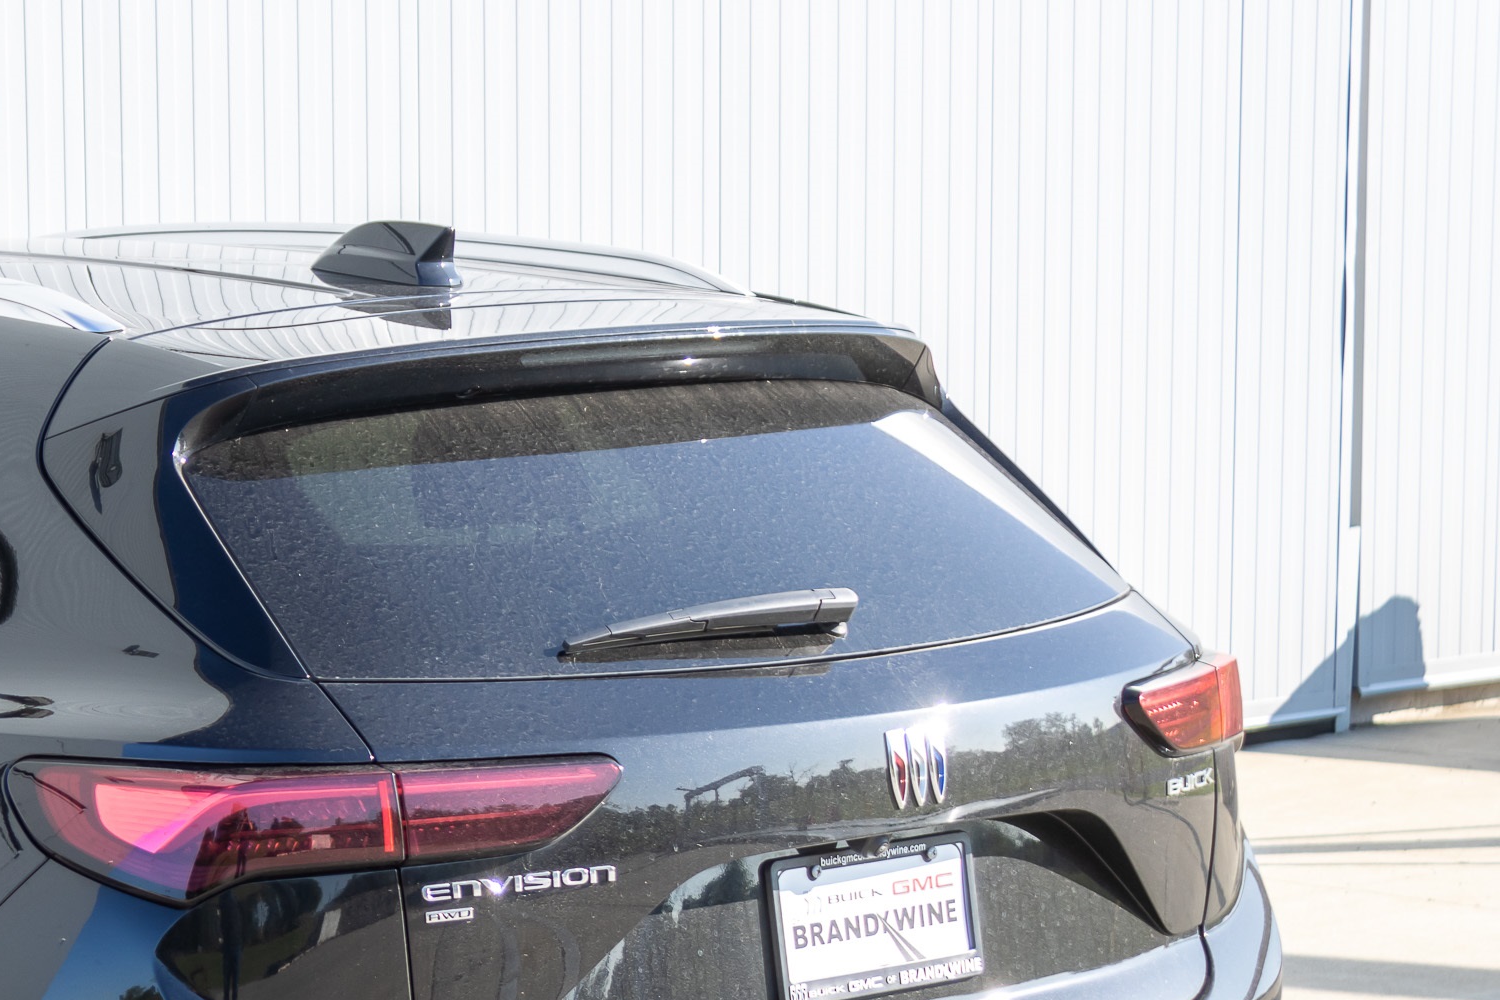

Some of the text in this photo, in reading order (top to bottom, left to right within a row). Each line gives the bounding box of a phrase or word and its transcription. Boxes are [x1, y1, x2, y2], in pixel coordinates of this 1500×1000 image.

[1165, 767, 1216, 796] BUICK
[820, 842, 927, 867] buickgmcodywine.com
[421, 864, 617, 902] ENVISION
[827, 872, 954, 905] BUICK GMC
[426, 908, 473, 923] AWD
[792, 898, 958, 949] BRANDYWINE
[808, 956, 984, 999] BUICK GMC OF BRANDYWINE
